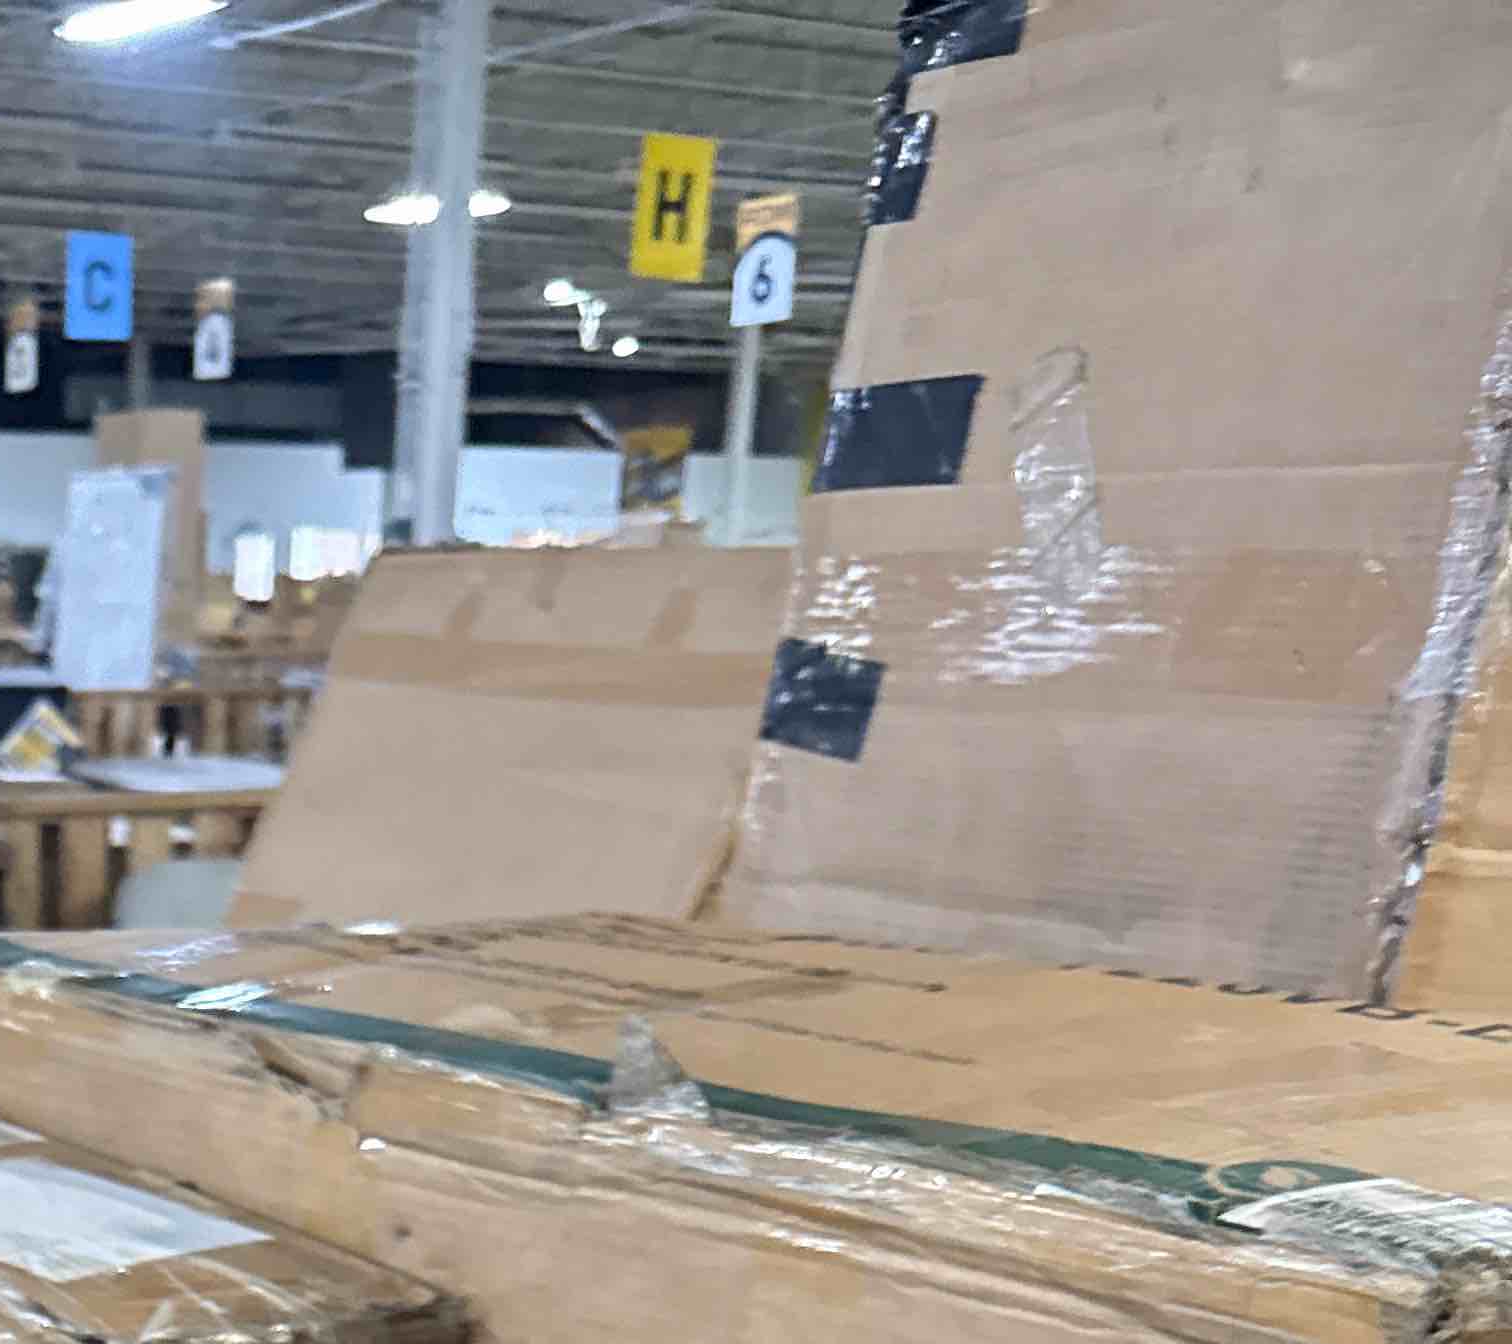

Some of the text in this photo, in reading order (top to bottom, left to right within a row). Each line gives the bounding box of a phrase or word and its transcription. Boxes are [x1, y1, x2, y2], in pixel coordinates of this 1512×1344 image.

[651, 170, 694, 245] H
[84, 260, 113, 313] C
[751, 254, 773, 304] 6
